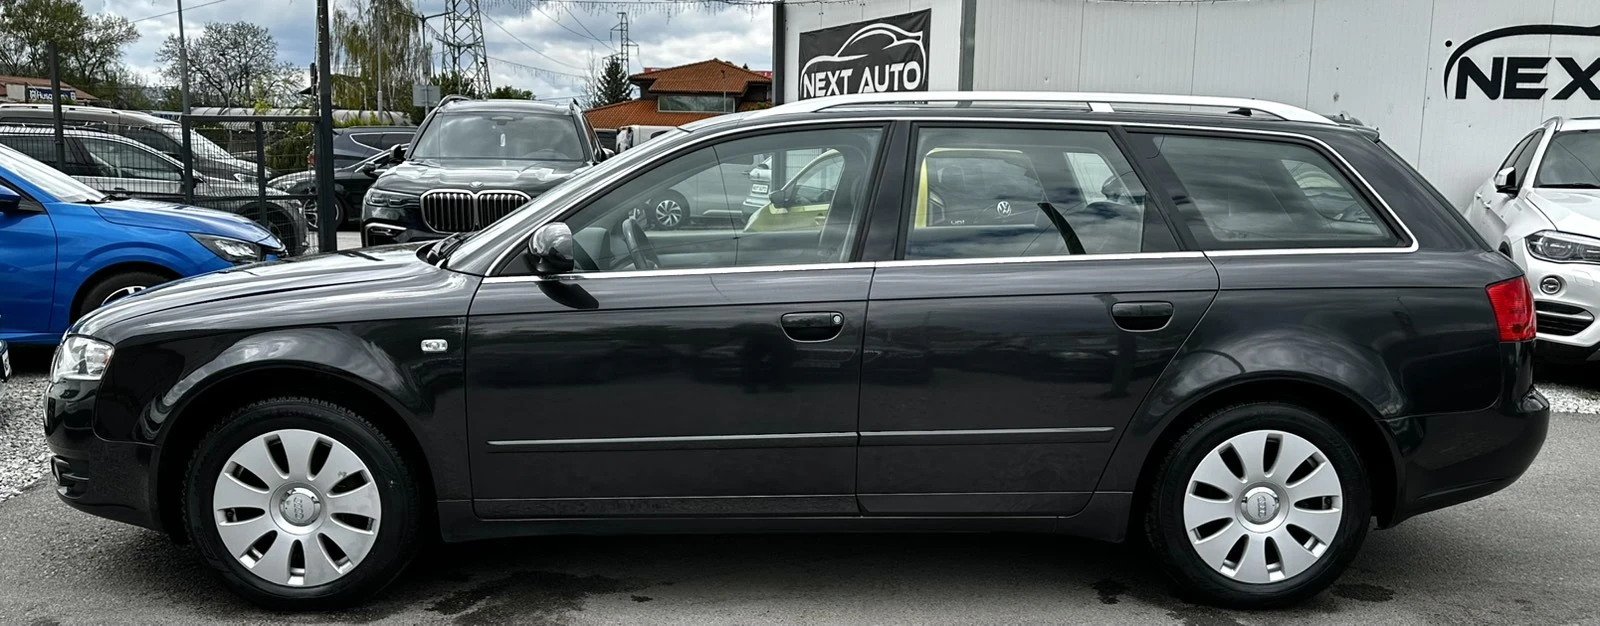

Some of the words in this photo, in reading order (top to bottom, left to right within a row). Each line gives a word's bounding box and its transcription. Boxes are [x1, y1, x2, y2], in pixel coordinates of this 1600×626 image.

[803, 68, 853, 98] NEXT
[858, 61, 921, 93] AUTO
[1455, 56, 1600, 100] NEX
